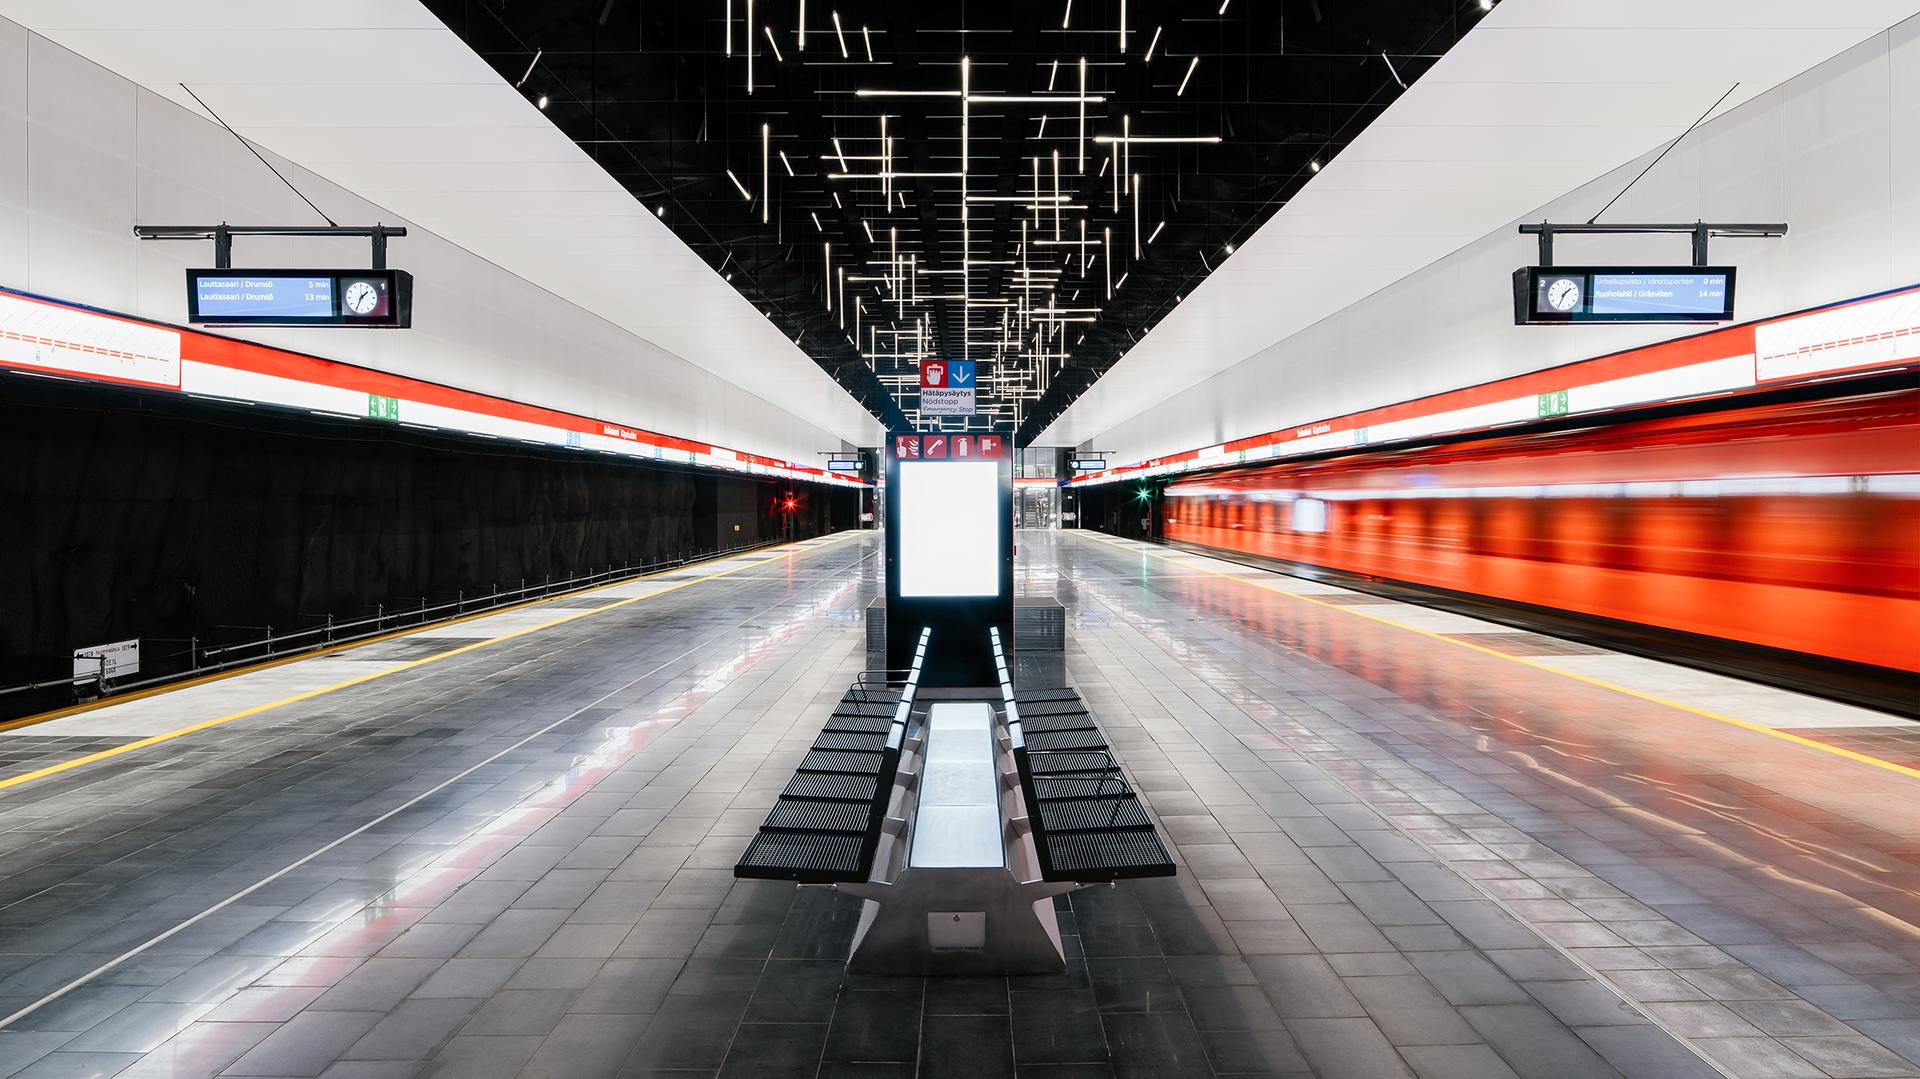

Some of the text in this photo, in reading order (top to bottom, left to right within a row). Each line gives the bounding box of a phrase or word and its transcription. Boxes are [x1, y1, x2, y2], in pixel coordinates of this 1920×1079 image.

[245, 293, 274, 301] Drumsö
[305, 293, 314, 301] 13
[315, 293, 330, 301] min
[1595, 290, 1632, 298] Ruoholahti
[1639, 290, 1673, 298] Gråsviken
[922, 390, 971, 398] Hätäpysäytys
